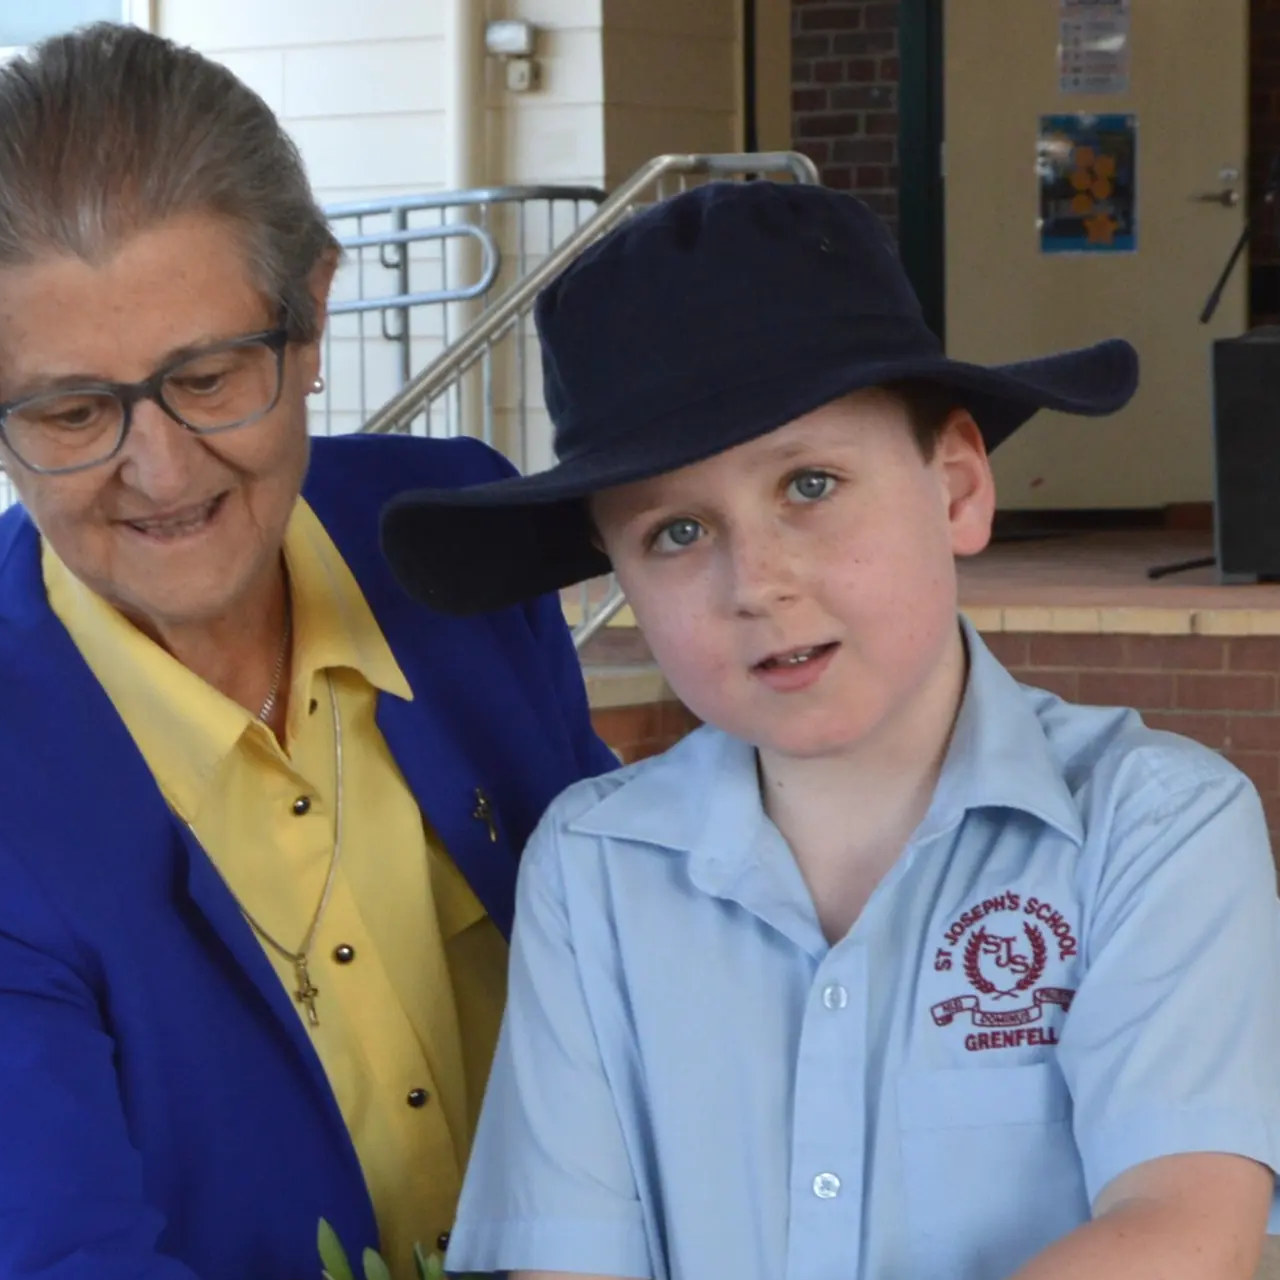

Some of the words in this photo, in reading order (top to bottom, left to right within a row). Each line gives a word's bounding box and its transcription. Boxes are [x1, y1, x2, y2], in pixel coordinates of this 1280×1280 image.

[934, 948, 953, 971] ST
[944, 889, 1021, 946] JOSEPH'S
[1023, 896, 1078, 961] SCHOOL
[964, 1027, 1059, 1051] GRENFELL
